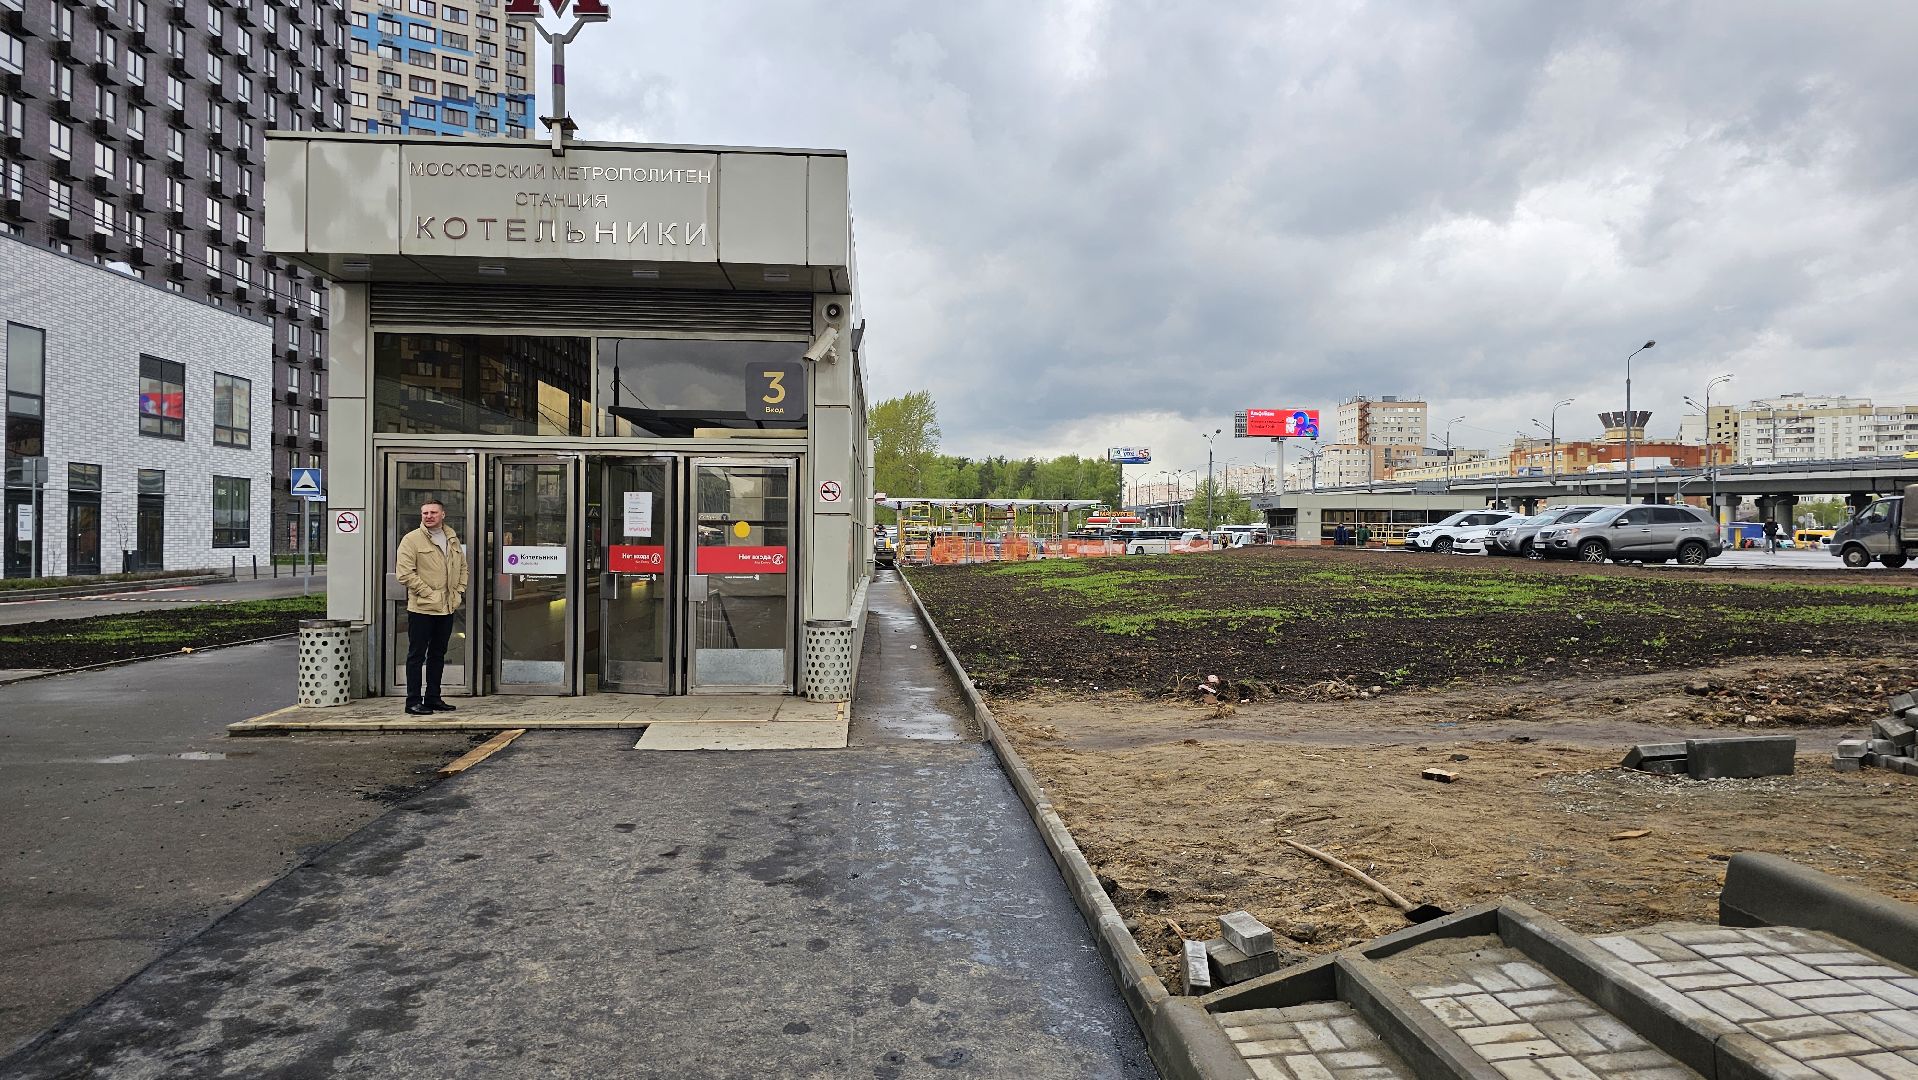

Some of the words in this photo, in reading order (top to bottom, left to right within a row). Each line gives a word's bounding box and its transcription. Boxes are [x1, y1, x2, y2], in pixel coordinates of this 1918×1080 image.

[409, 162, 546, 179] МОСКОВСКИЙ
[552, 165, 711, 184] МЕТРОПОЛИТЕН
[515, 192, 608, 211] СТАНЦИЯ
[415, 216, 707, 246] КОТЕЛЬНИКИ
[762, 371, 786, 404] 3
[765, 406, 785, 414] Вход
[520, 553, 558, 561] Котельники
